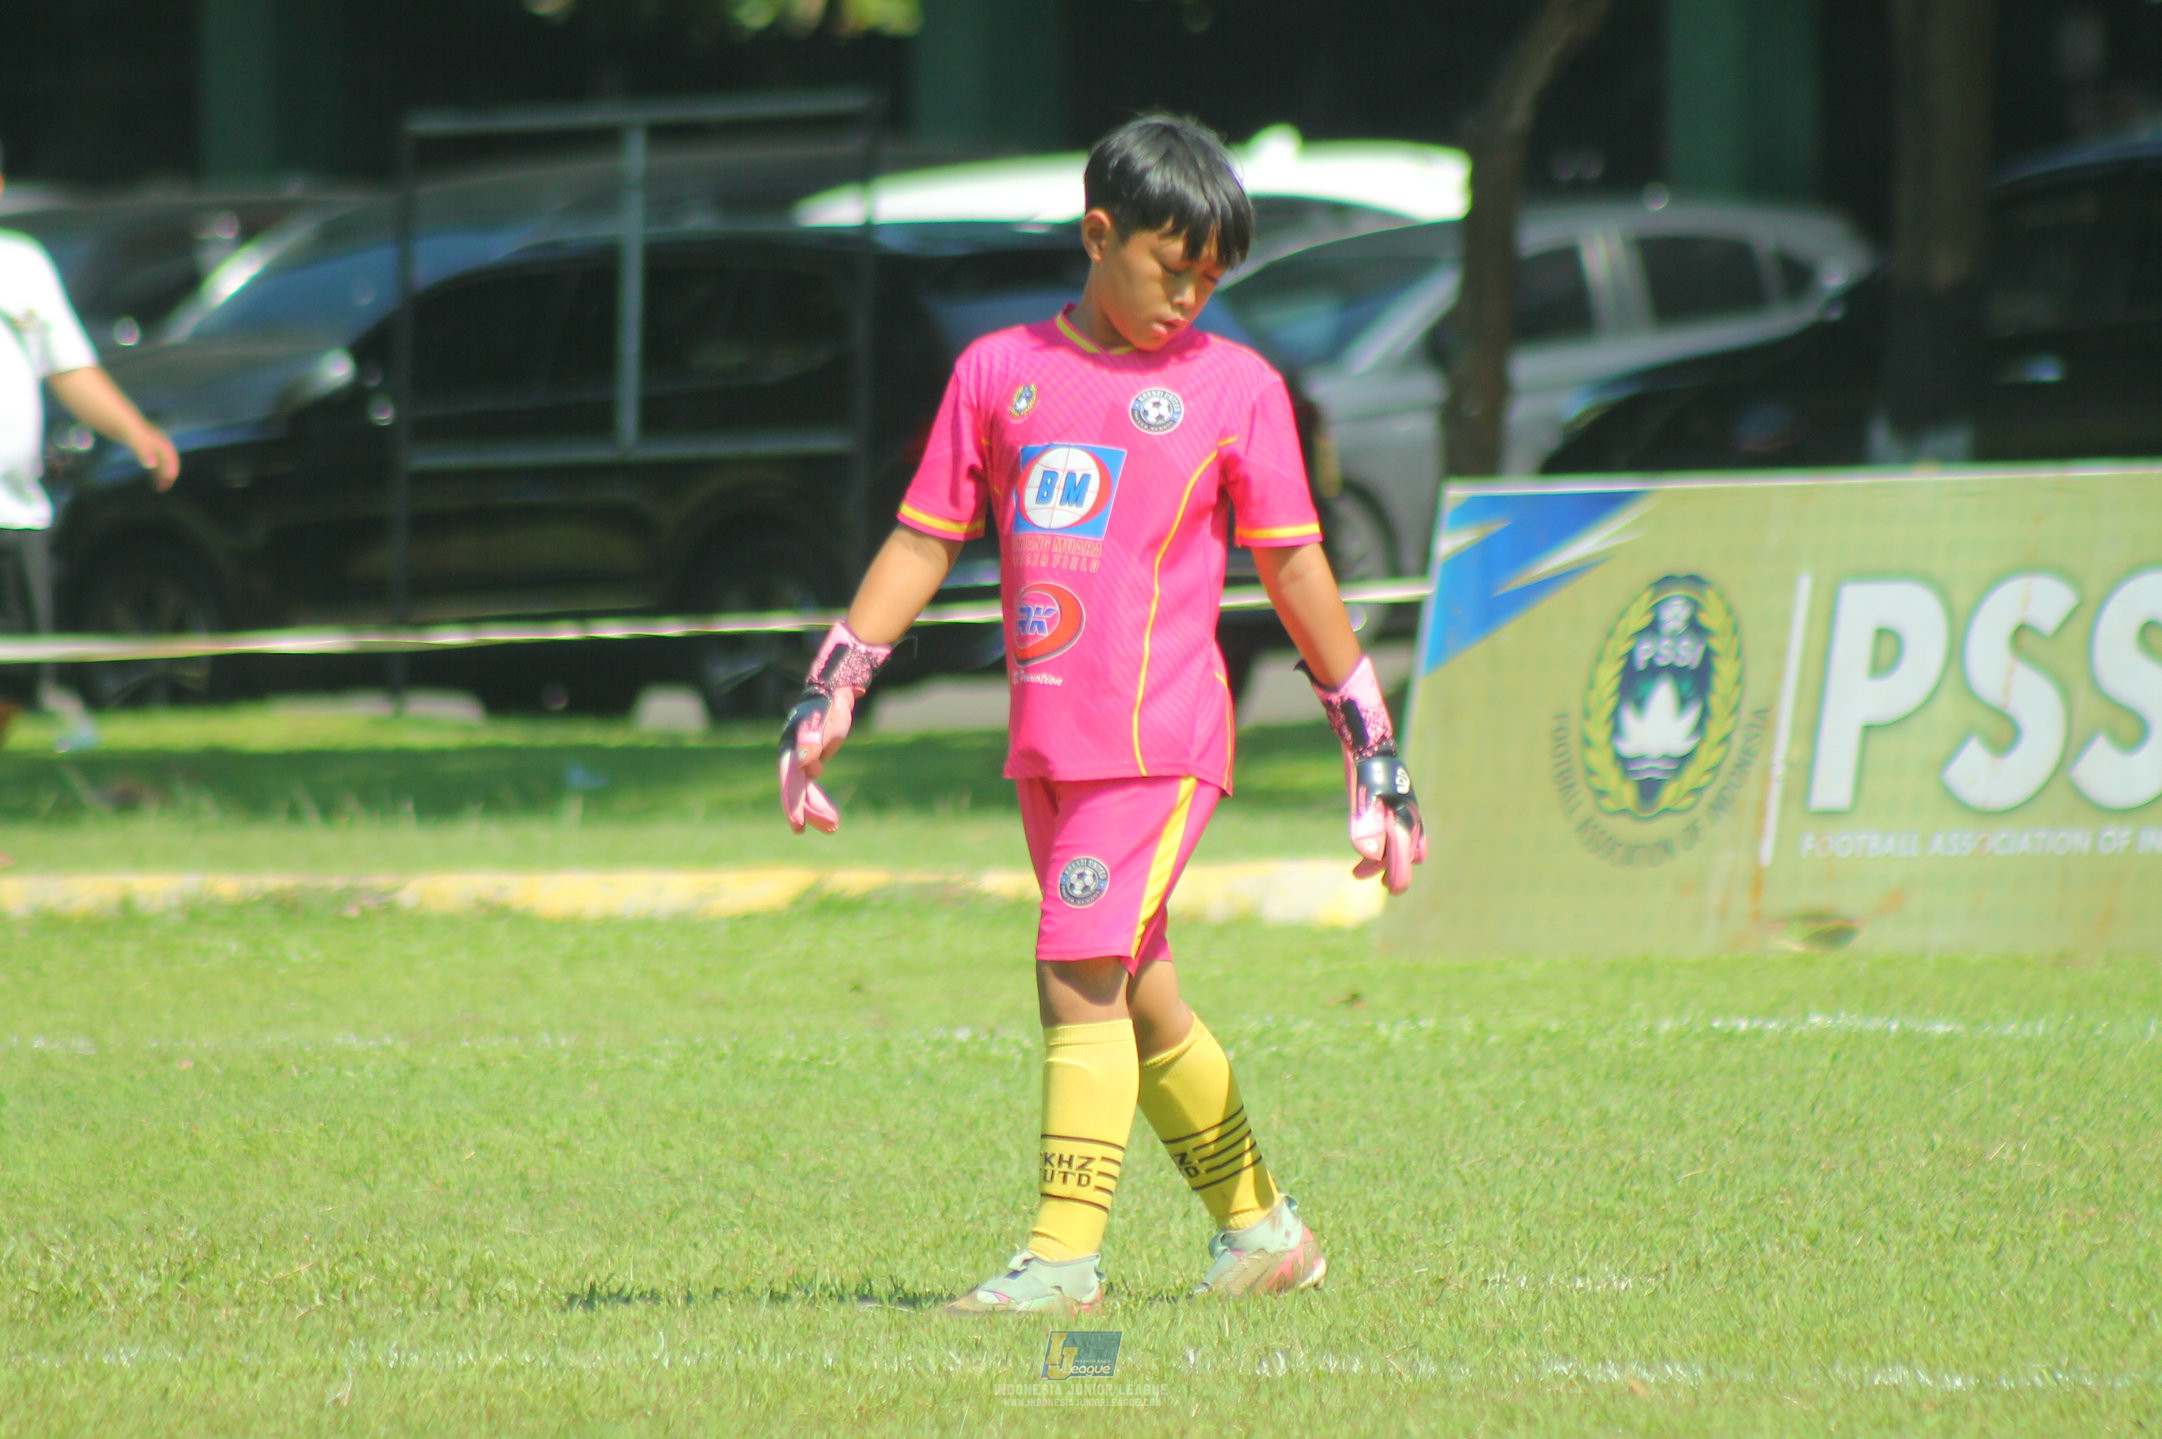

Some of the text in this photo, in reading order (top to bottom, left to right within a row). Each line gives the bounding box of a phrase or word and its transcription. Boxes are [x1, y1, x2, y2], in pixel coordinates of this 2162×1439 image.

[1035, 470, 1092, 508] BM
[1635, 636, 1705, 671] PSSI
[1807, 571, 2162, 815] PSS
[1800, 831, 1921, 859] FOOTBALL
[1926, 829, 2093, 858] ASSOCIATION
[2096, 825, 2133, 857] OF
[1043, 1168, 1092, 1187] UTD
